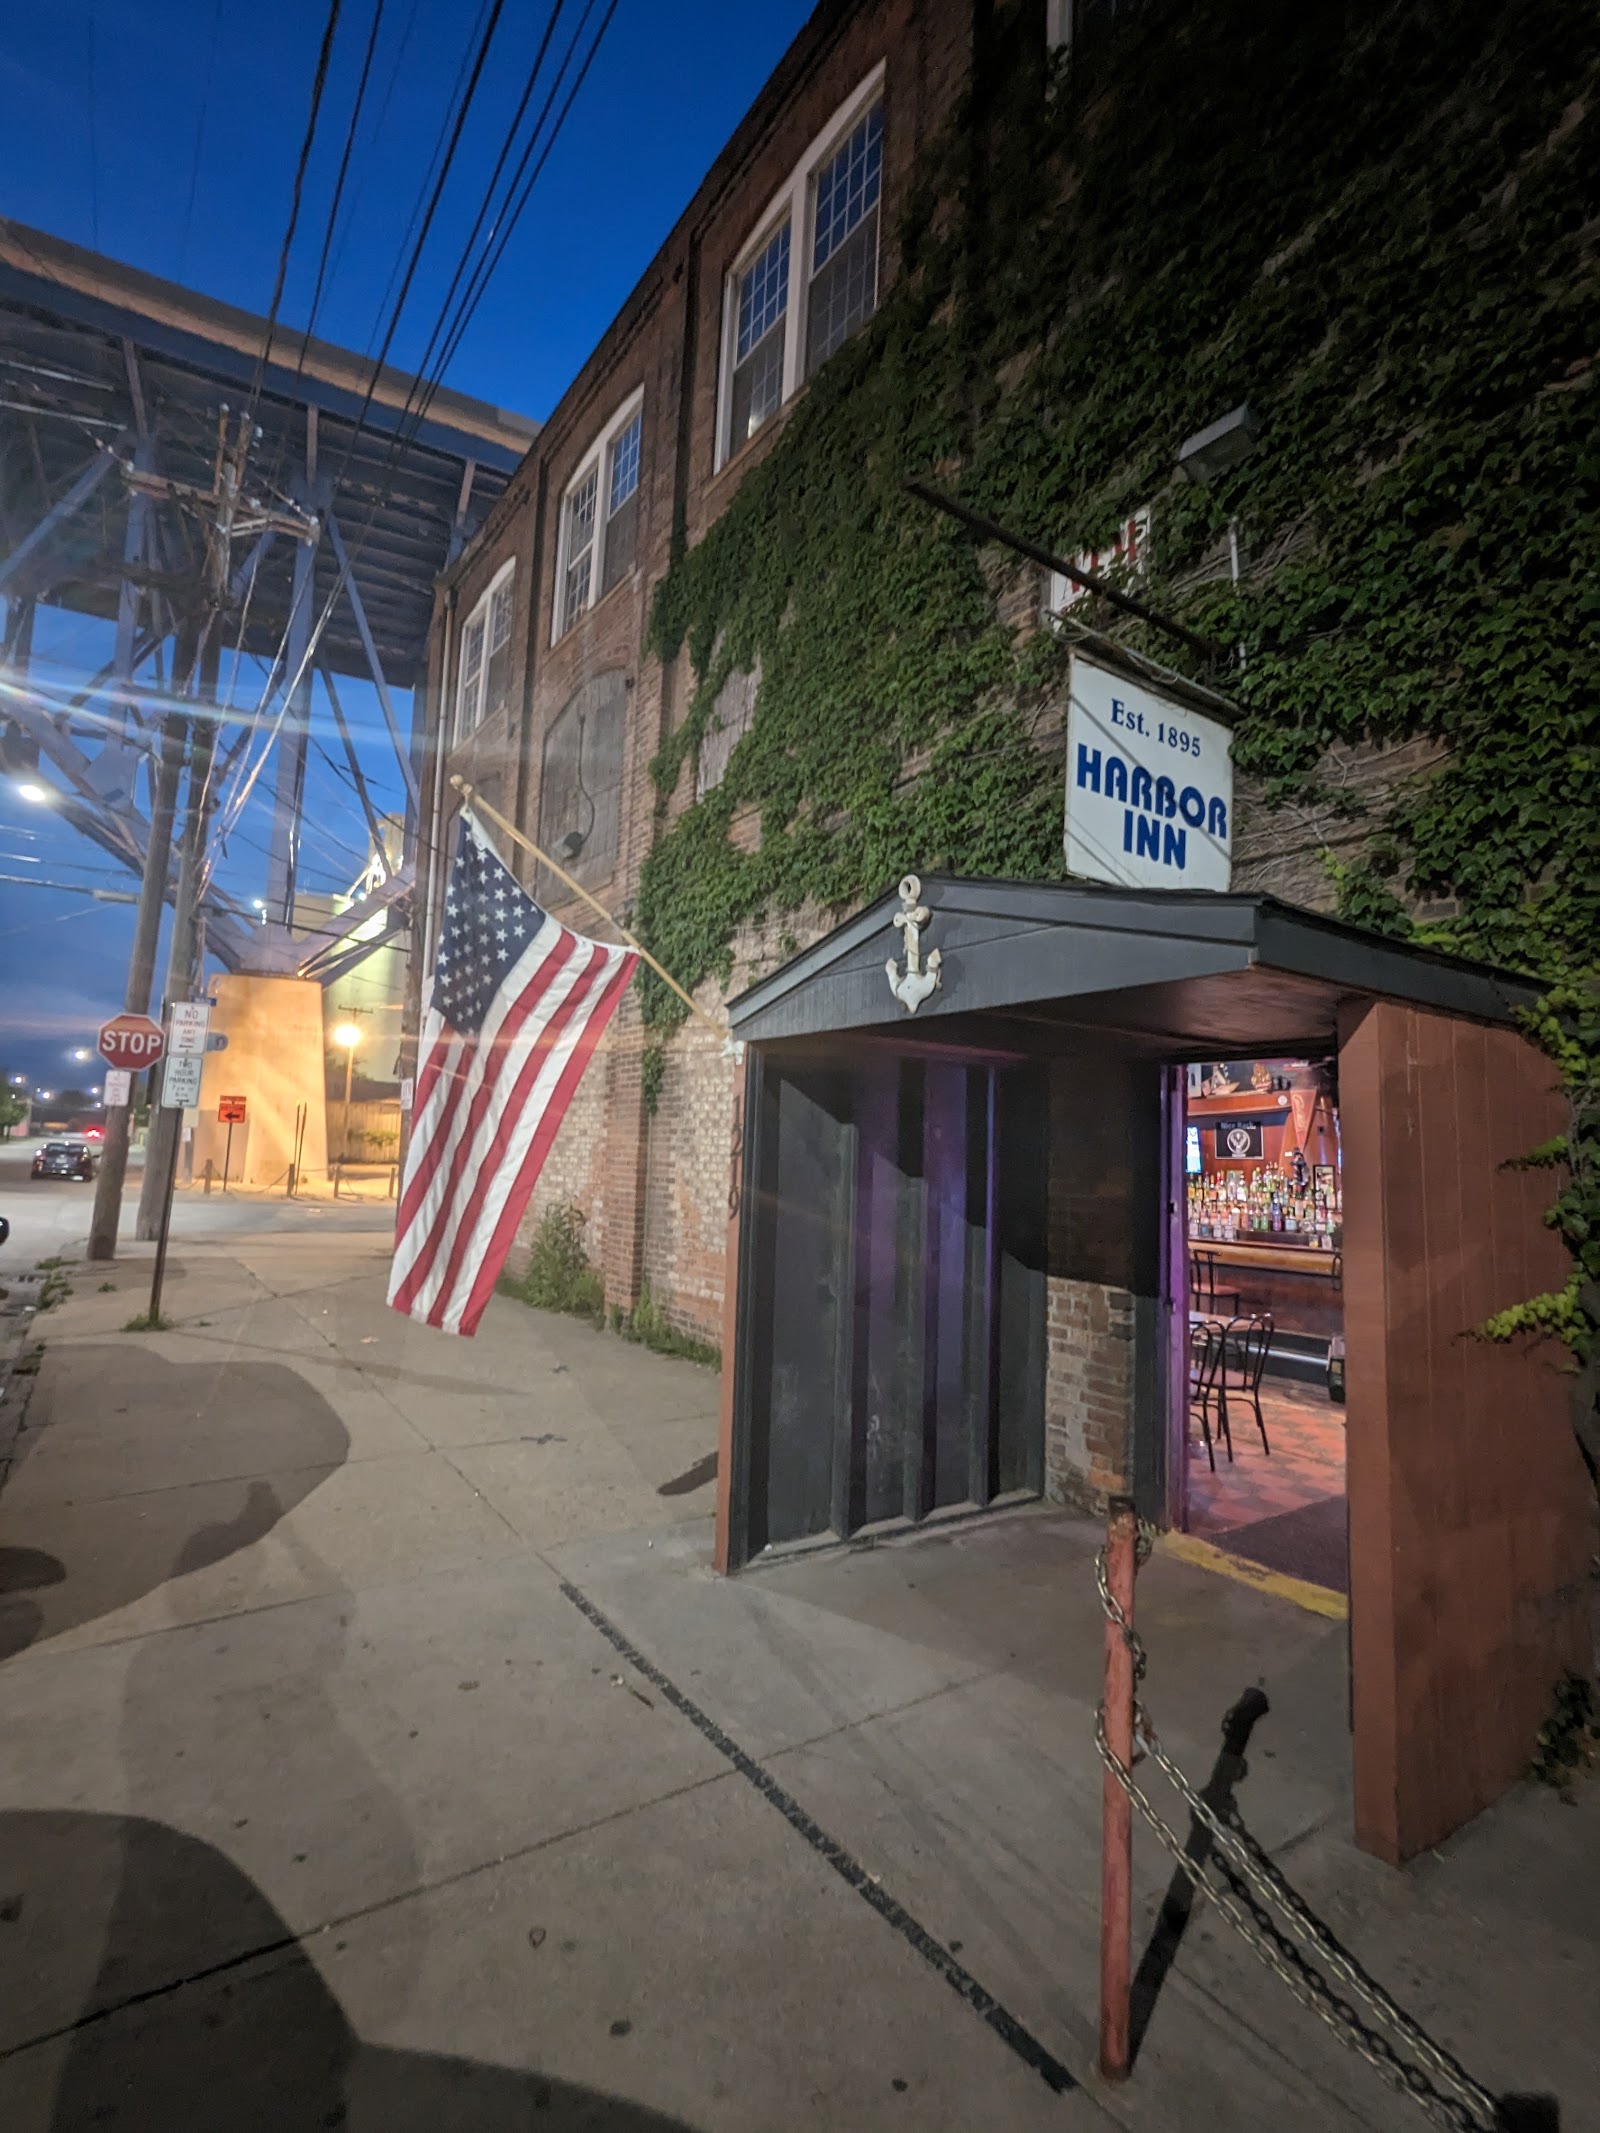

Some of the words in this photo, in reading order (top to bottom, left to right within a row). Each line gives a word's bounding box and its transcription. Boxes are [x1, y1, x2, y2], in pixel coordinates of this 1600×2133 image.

[1111, 698, 1150, 737] Est.
[1158, 722, 1201, 758] 1895
[1076, 742, 1227, 840] HARBOR
[1123, 808, 1186, 871] INN
[175, 1020, 206, 1029] PARKING
[184, 1010, 199, 1020] NO
[102, 1030, 161, 1055] STOP
